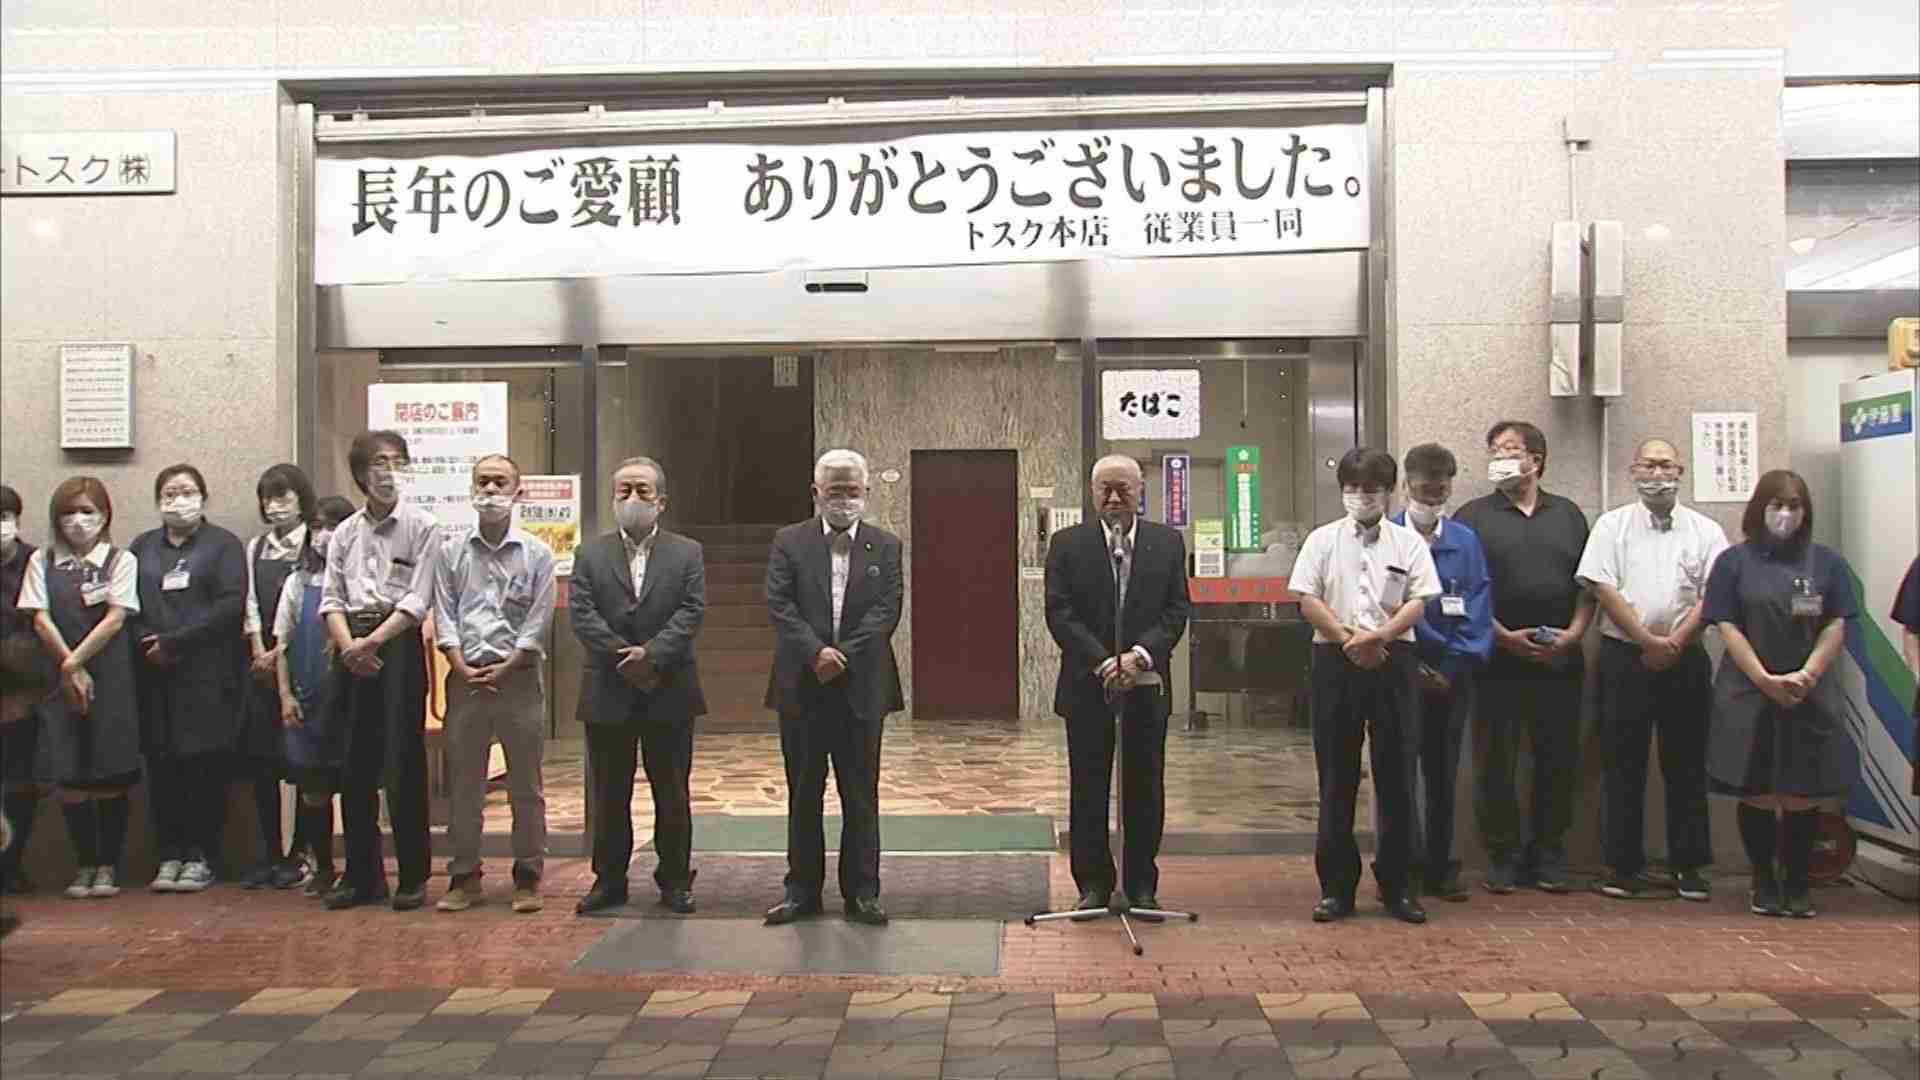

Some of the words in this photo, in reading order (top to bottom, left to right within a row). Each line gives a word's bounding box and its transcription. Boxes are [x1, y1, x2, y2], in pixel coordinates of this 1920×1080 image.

[351, 154, 681, 236] 長年のご愛顧
[743, 132, 1361, 223] ありがとうございました。
[967, 214, 1108, 250] トスク本店
[1144, 208, 1303, 244] 従業員一同
[1120, 391, 1181, 418] たばこ
